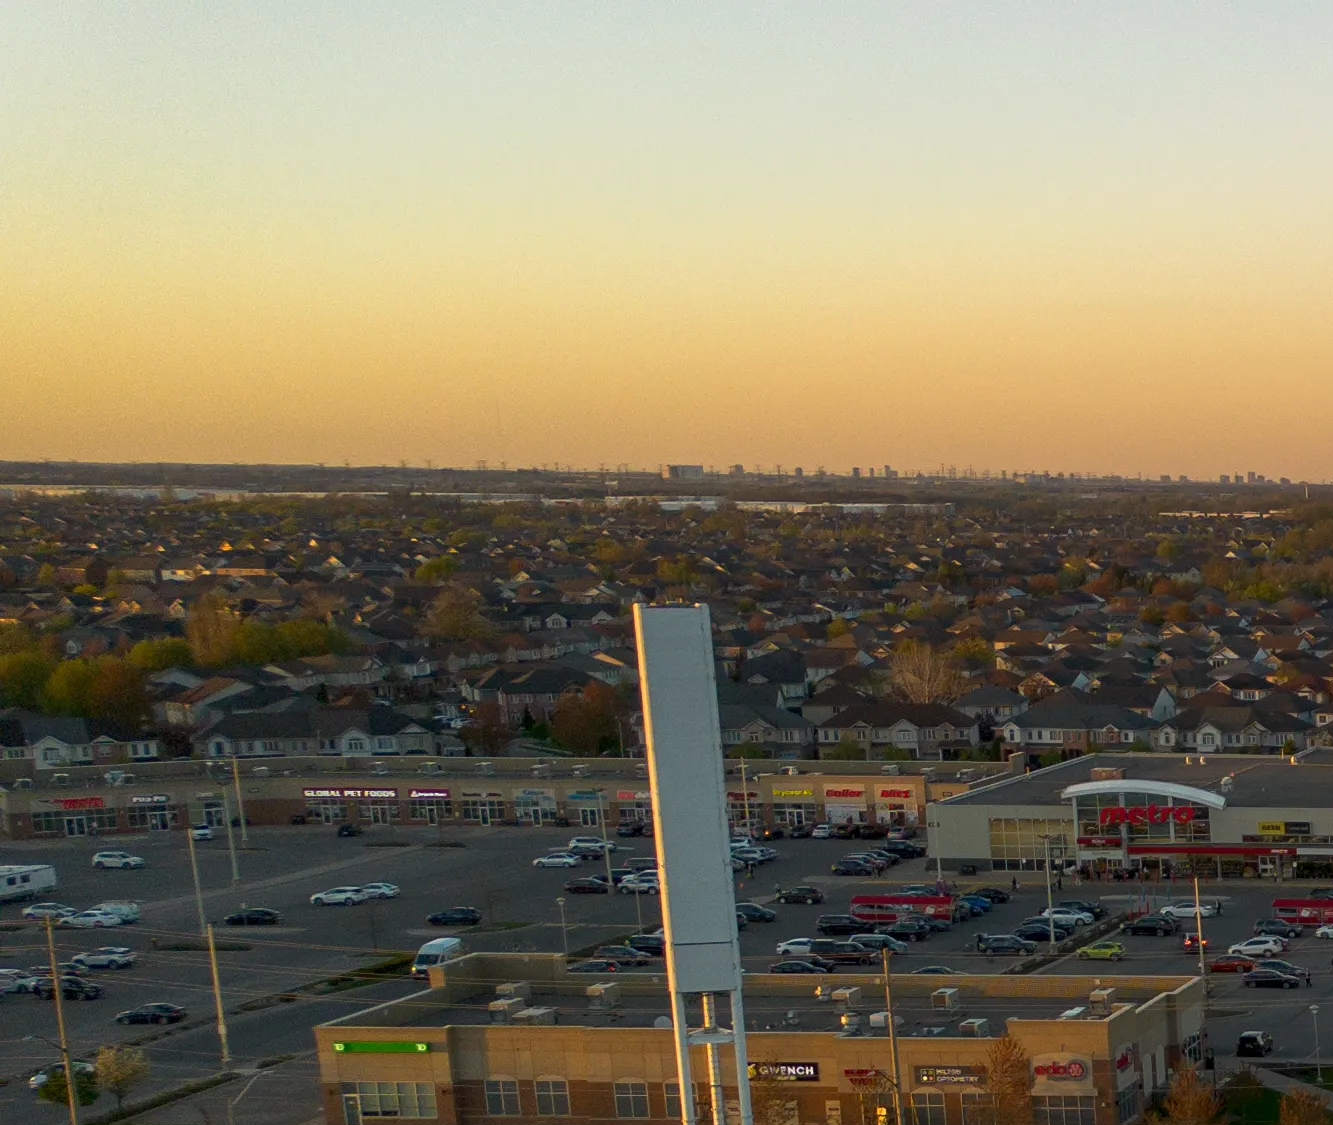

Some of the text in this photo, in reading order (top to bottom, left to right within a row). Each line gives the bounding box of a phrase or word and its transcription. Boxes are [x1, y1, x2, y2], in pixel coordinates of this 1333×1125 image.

[304, 790, 396, 798] GLOBAL PET FOODS
[1100, 804, 1195, 825] metro
[333, 1043, 345, 1051] TD
[415, 1043, 427, 1051] TD
